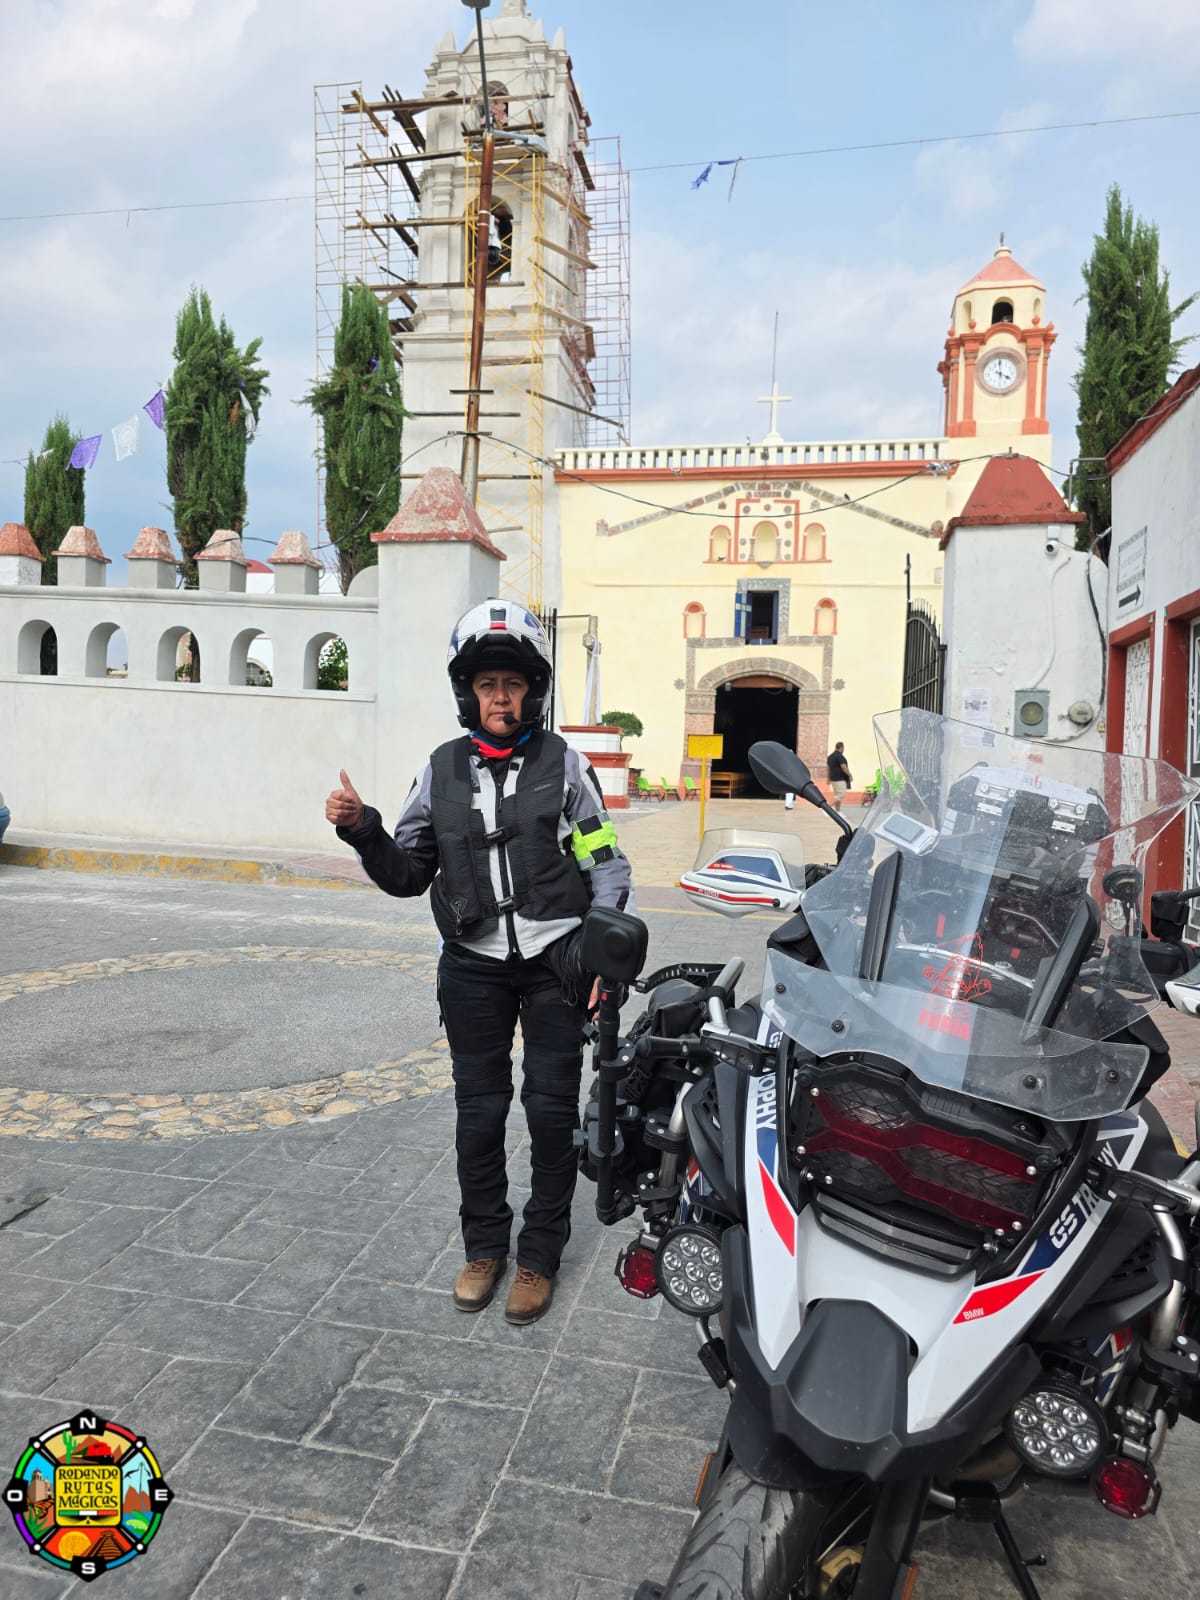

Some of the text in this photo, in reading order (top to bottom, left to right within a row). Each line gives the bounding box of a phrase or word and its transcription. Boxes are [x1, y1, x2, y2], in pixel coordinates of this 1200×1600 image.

[756, 1072, 777, 1130] OPHY
[1049, 1141, 1121, 1249] GS TRHY
[962, 1307, 985, 1320] BMW
